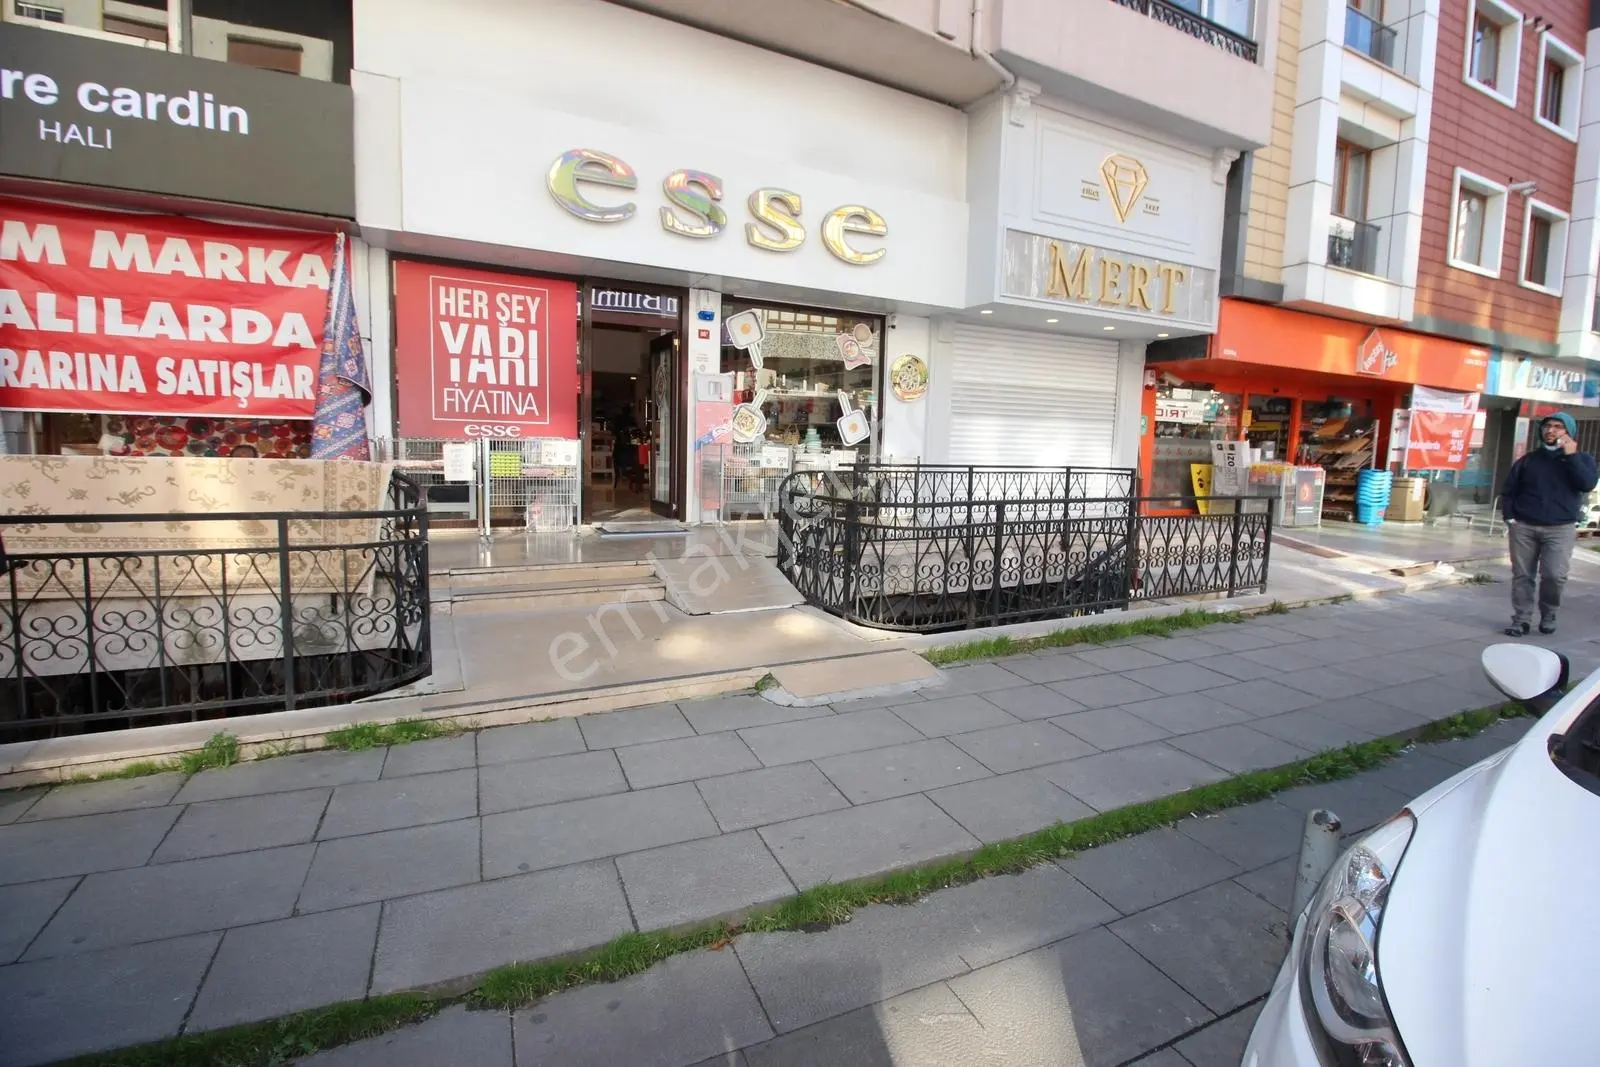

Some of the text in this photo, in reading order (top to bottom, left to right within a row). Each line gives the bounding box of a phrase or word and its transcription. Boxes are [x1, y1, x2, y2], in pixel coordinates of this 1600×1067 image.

[39, 119, 112, 150] HALI
[77, 81, 249, 135] cardin
[545, 148, 888, 266] esse
[89, 229, 330, 290] MARKA
[1047, 241, 1184, 314] MERT
[0, 288, 317, 349] ALILARDA
[439, 285, 541, 327] HER ŞEY
[155, 356, 316, 408] SATIŞLAR
[442, 383, 539, 416] FİYATINA
[463, 424, 521, 437] esse
